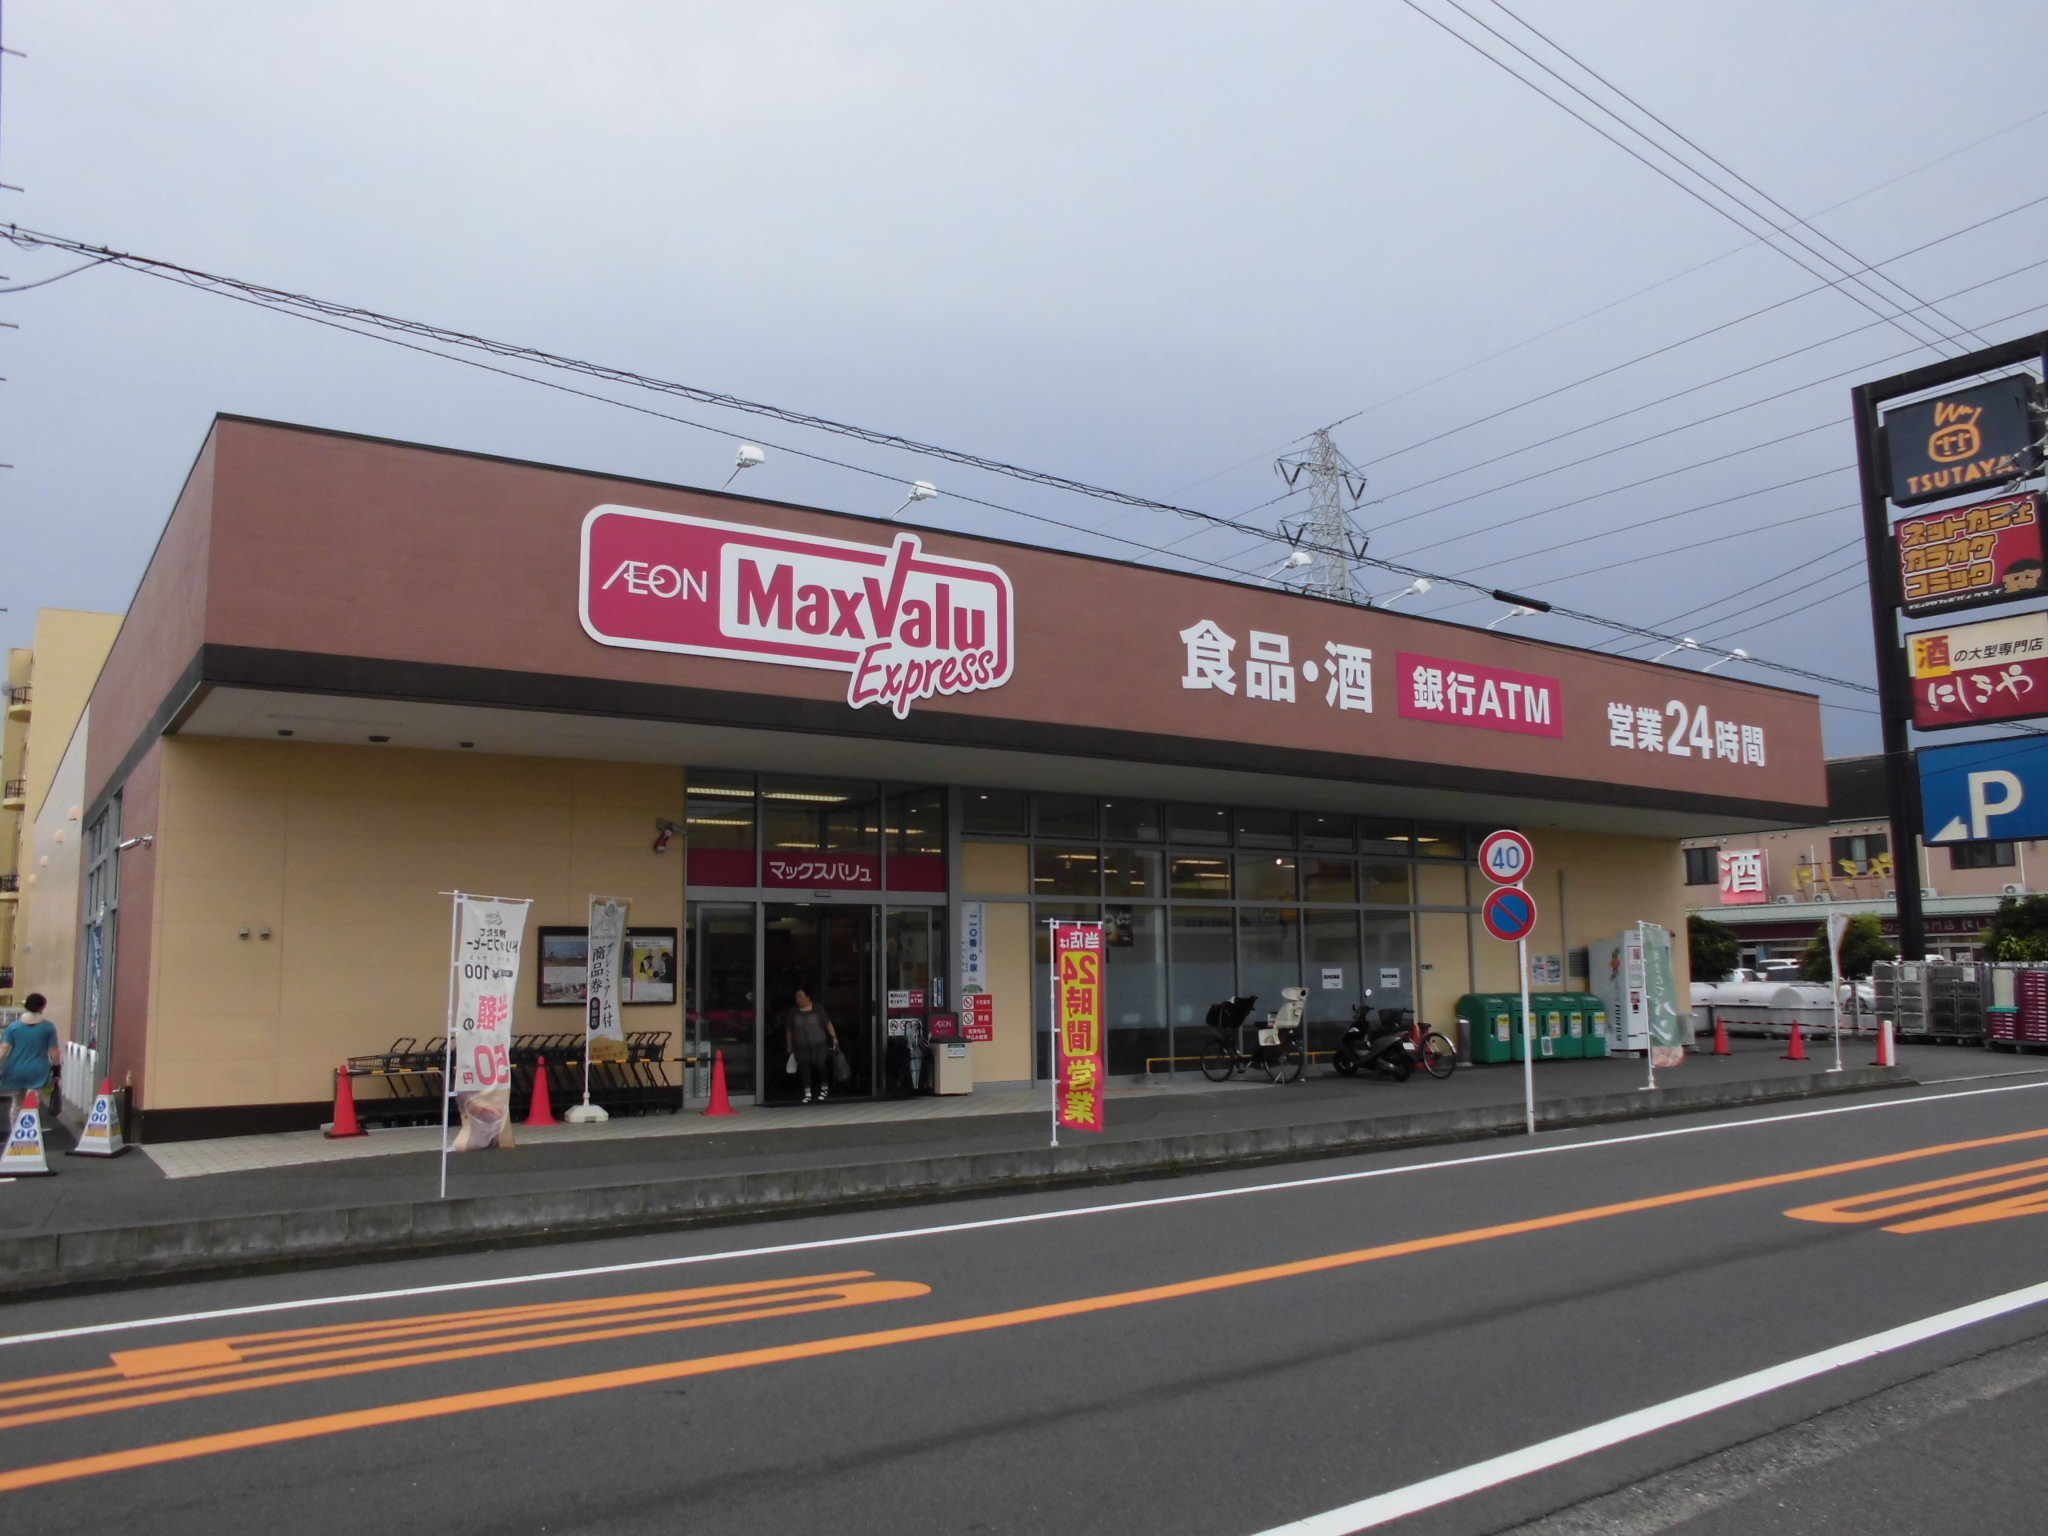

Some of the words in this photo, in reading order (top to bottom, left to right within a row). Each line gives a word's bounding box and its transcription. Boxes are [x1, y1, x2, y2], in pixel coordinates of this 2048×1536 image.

[1908, 455, 2016, 494] TSUTAYA
[1903, 501, 2035, 547] ネットカフェ
[737, 541, 986, 652] MaxValu
[1905, 560, 1995, 599] コミック
[1179, 619, 1373, 713] 食品・酒
[1917, 634, 1950, 669] 酒
[1954, 637, 2045, 663] の大型専門店
[851, 641, 994, 714] Express
[1412, 665, 1551, 725] 銀行ATM
[1607, 699, 1766, 767] 営業24時間
[1968, 770, 2023, 839] P
[769, 861, 872, 882] マックスバリュ
[1492, 846, 1521, 869] 40
[1720, 850, 1764, 894] 酒
[590, 945, 606, 994] 商品券
